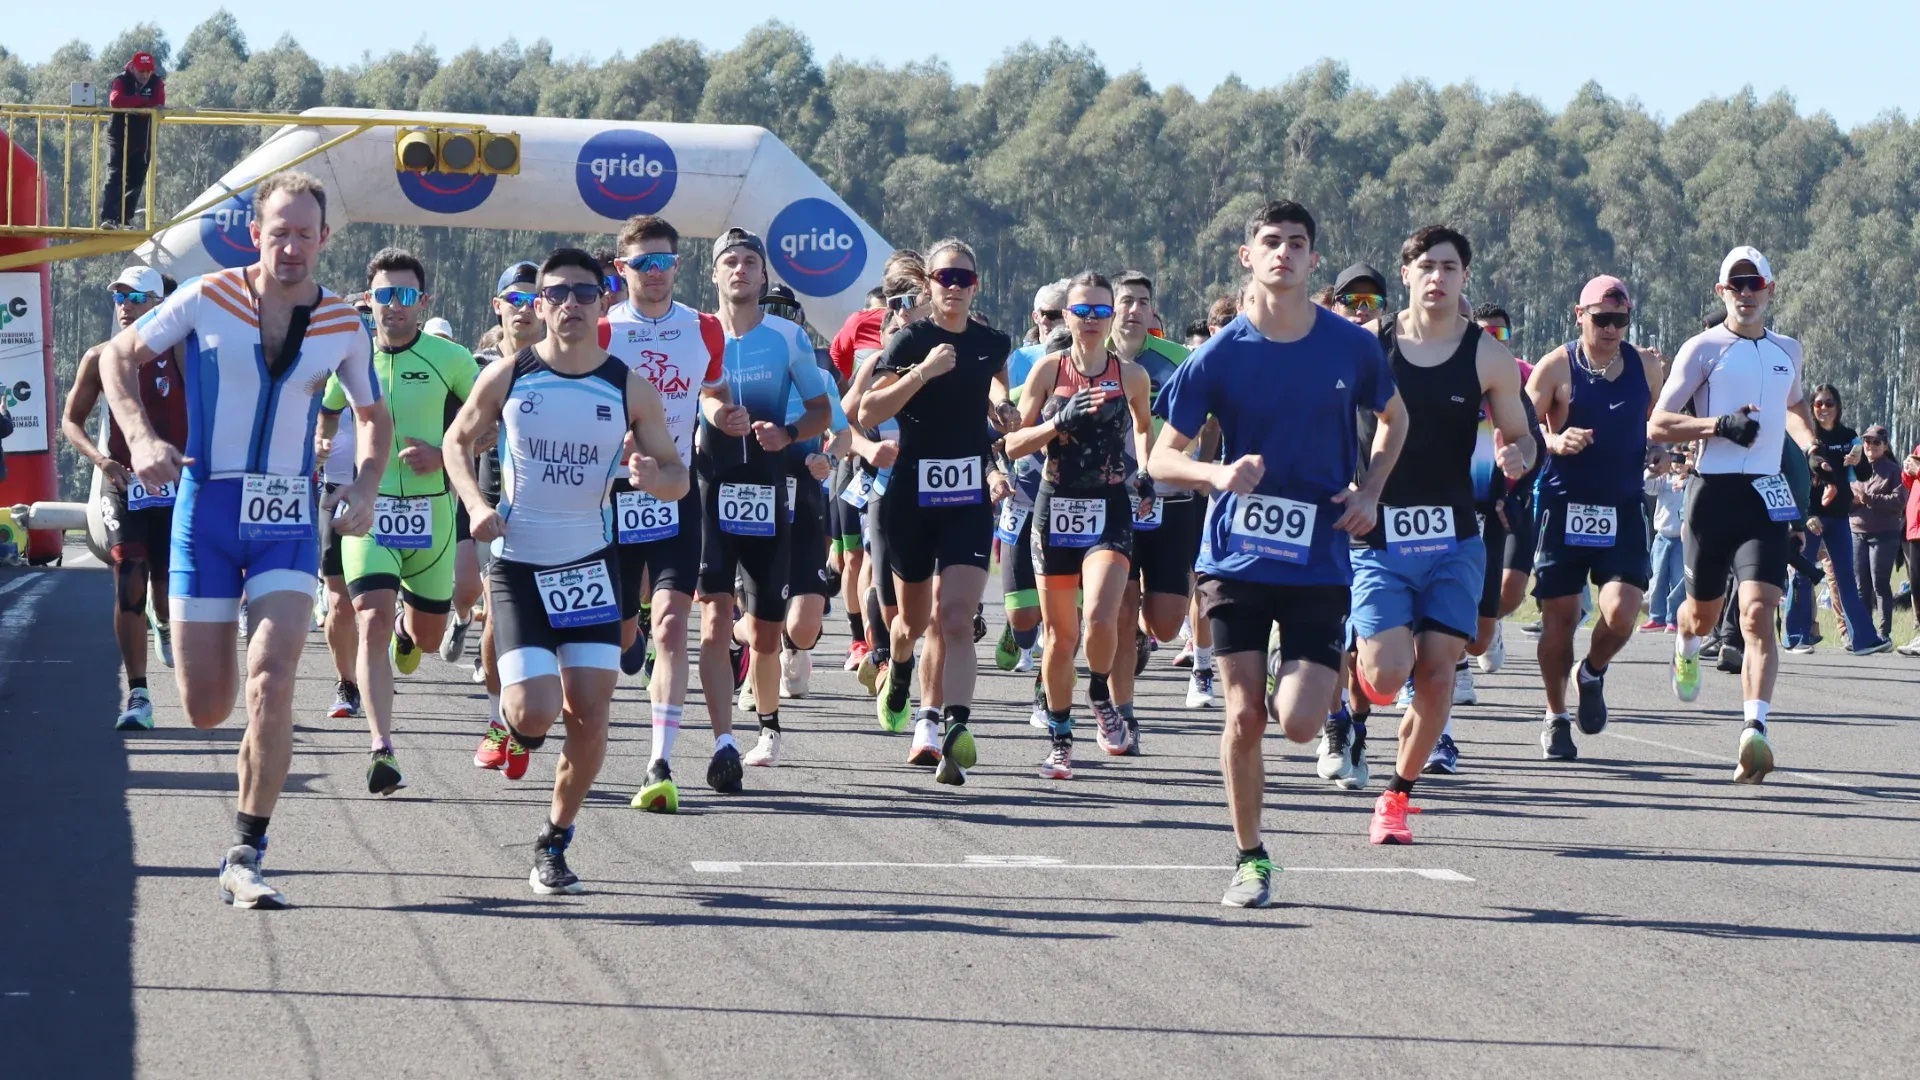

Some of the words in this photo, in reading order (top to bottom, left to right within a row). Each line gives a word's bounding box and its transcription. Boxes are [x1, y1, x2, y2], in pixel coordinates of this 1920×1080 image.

[590, 153, 663, 183] grido
[215, 204, 252, 232] gri
[780, 227, 853, 258] grido
[667, 392, 688, 400] TEAM
[528, 437, 599, 465] VILLALBA
[541, 464, 584, 486] ARG
[927, 463, 973, 488] 601
[248, 497, 303, 523] 064
[724, 500, 769, 521] 020
[1765, 488, 1793, 508] 053
[379, 514, 426, 535] 009
[624, 506, 672, 529] 063
[1056, 514, 1097, 534] 051
[1244, 502, 1306, 539] 699
[1393, 507, 1448, 537] 603
[1571, 516, 1611, 535] 029
[549, 583, 607, 612] 022
